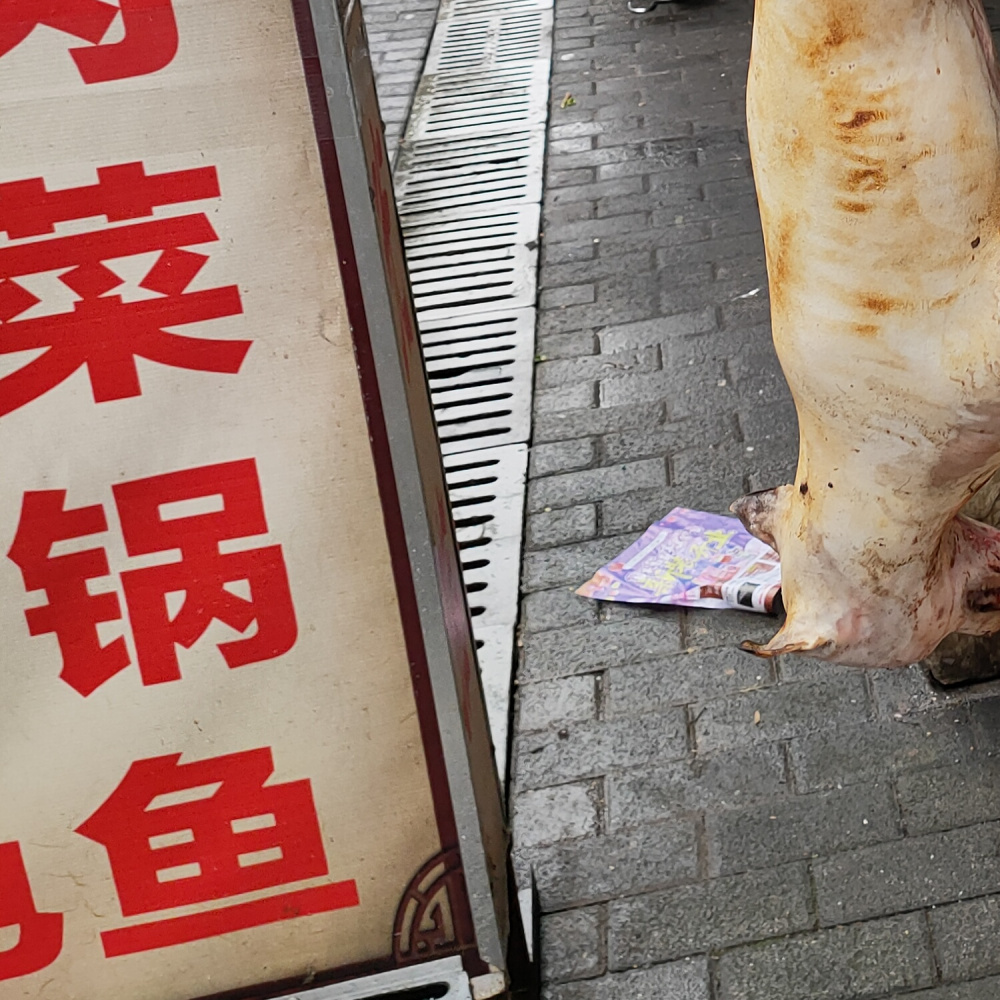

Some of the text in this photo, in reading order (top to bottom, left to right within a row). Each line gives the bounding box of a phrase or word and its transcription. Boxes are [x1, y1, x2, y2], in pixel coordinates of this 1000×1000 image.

[0, 161, 254, 418] 菜
[6, 457, 298, 698] 锅
[0, 745, 361, 981] 鱼
